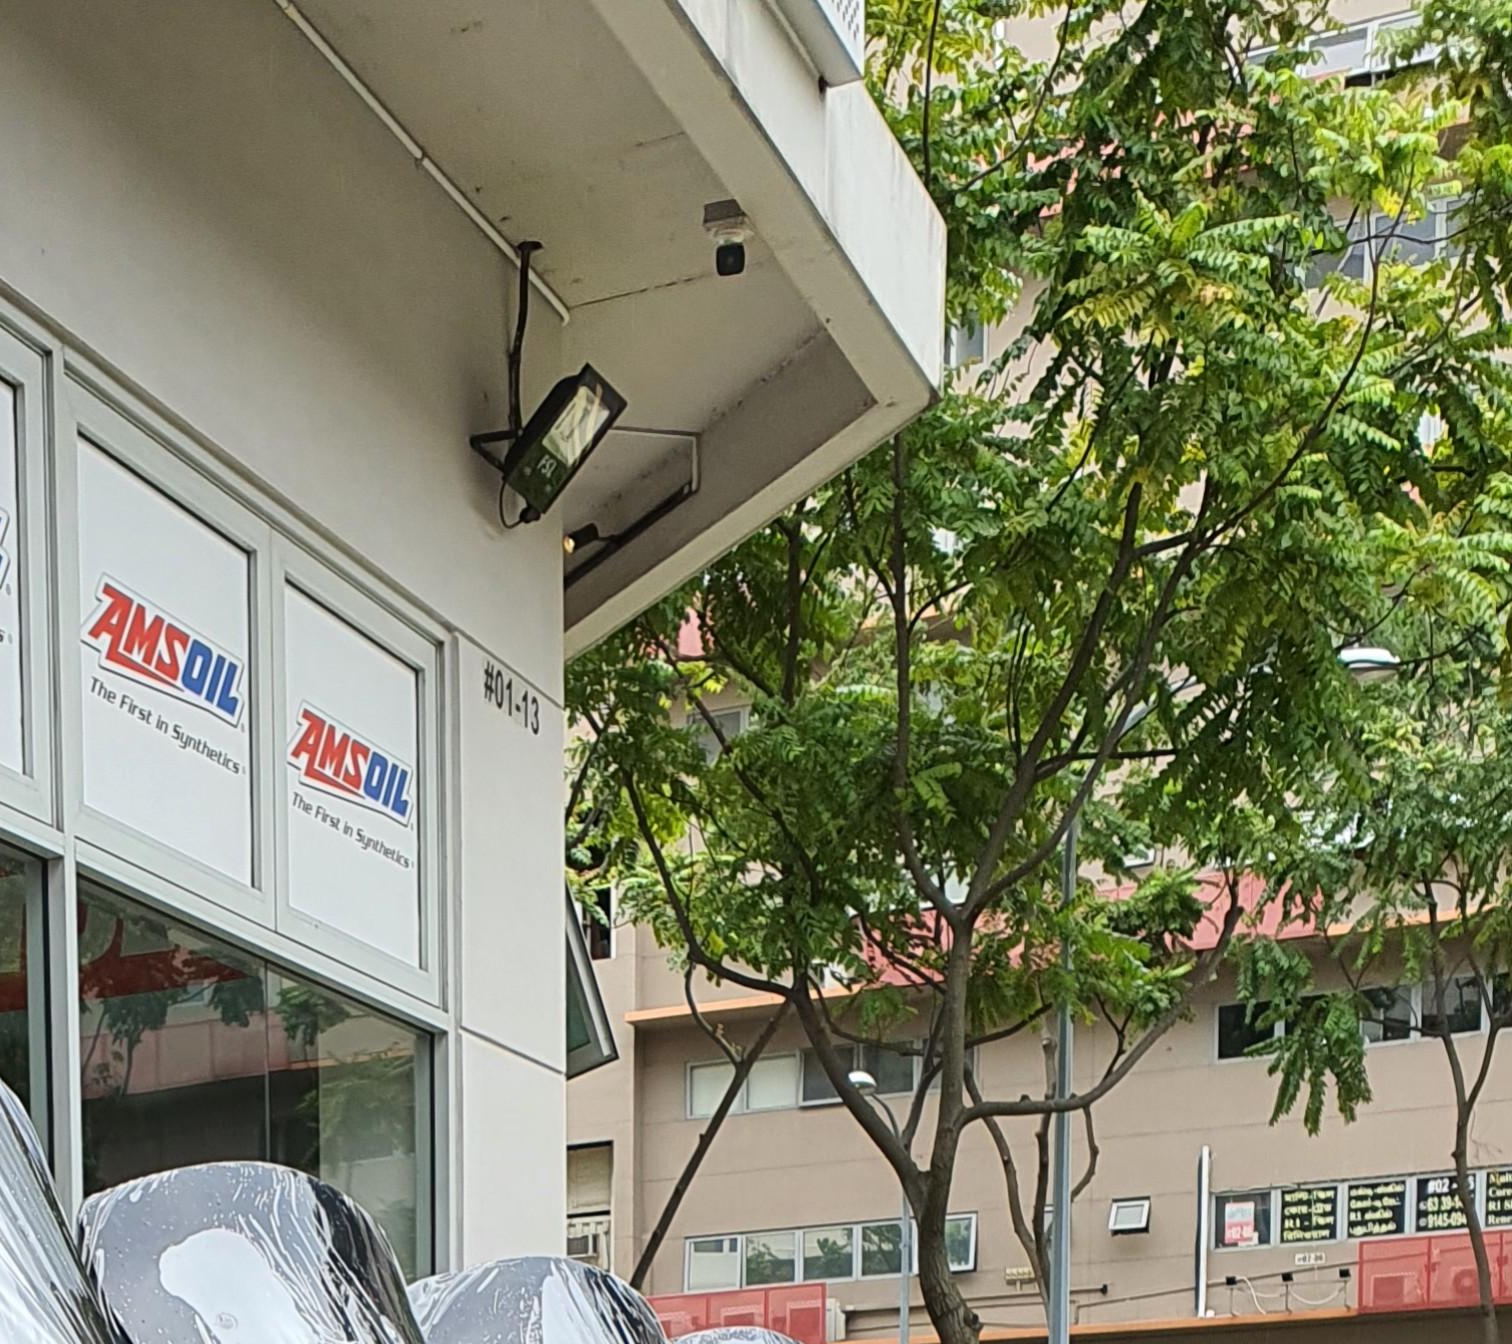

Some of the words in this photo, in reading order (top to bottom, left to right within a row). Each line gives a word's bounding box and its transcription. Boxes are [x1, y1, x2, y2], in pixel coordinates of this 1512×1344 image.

[87, 581, 239, 718] AMSOIL
[483, 660, 540, 736] #01-13
[89, 676, 117, 706] The
[119, 694, 153, 726] First
[155, 714, 169, 735] in
[171, 723, 241, 776] Synthetics
[290, 707, 410, 819] AMSOIL
[291, 791, 314, 816] The
[314, 804, 342, 831] First
[342, 820, 354, 838] in
[355, 827, 410, 870] Synthetics
